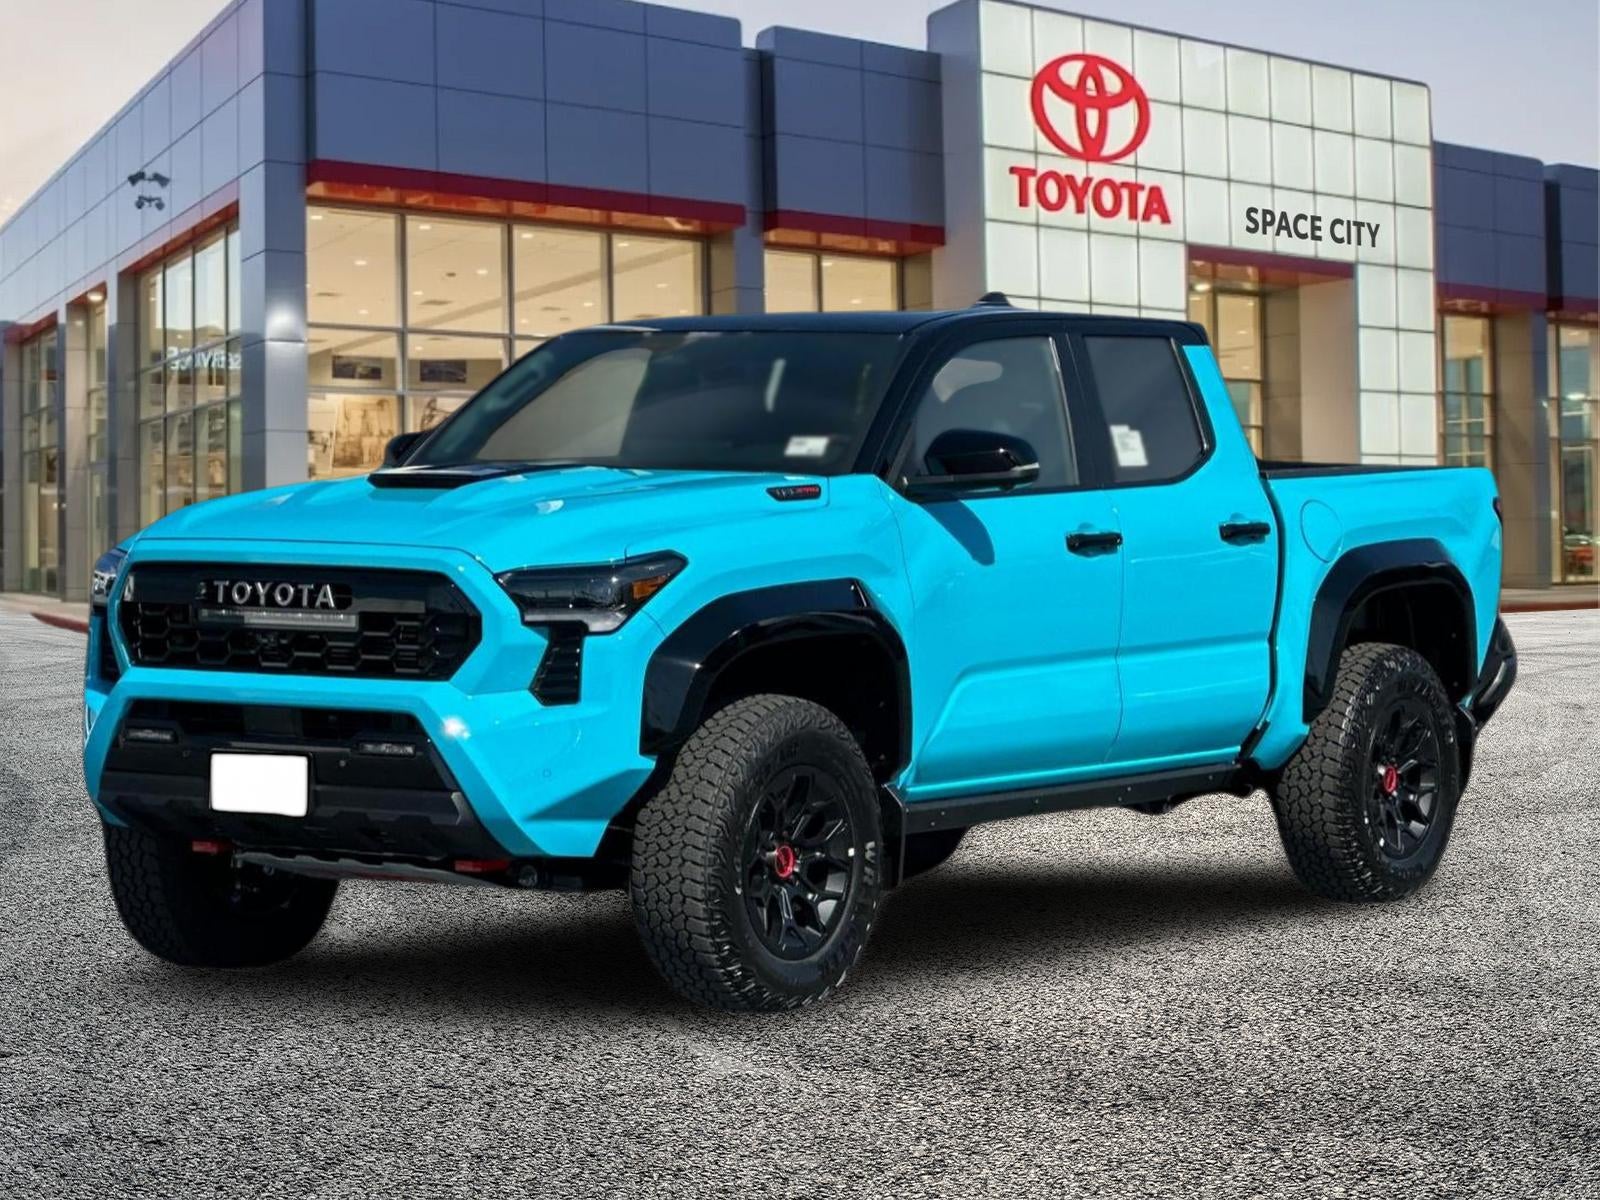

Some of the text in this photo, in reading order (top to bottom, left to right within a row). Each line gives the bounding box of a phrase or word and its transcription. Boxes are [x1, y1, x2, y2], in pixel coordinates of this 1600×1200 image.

[1009, 166, 1171, 224] TOYOTA
[1245, 207, 1380, 248] SPACE CITY
[213, 580, 335, 608] TOYOTA
